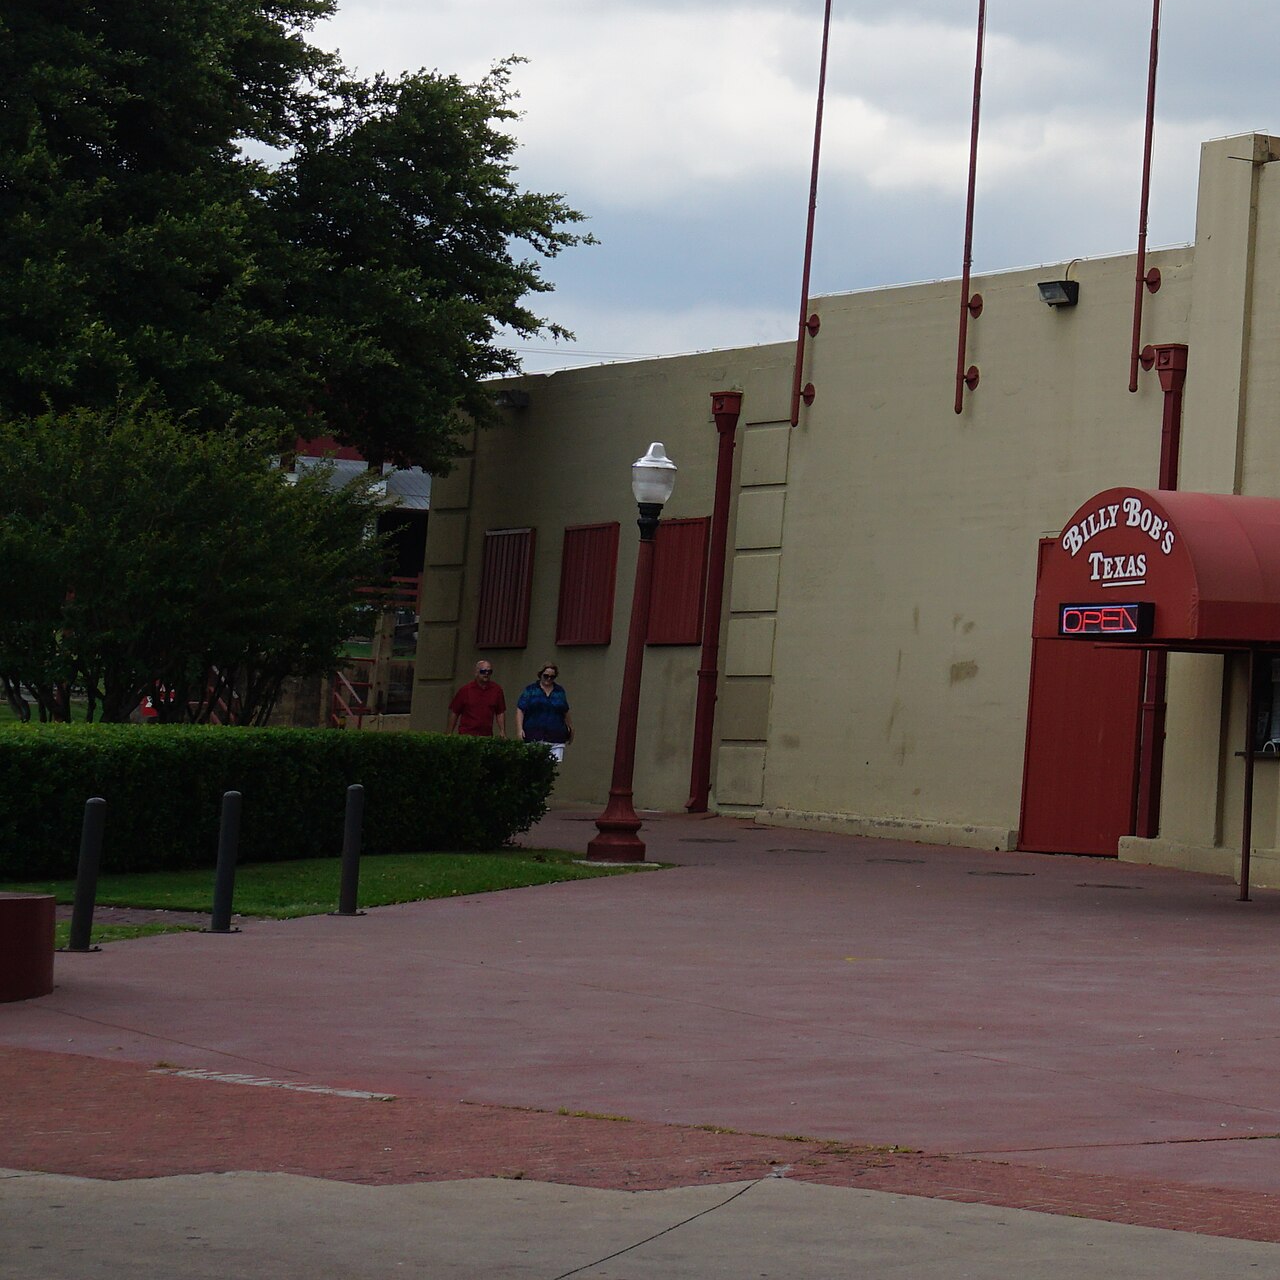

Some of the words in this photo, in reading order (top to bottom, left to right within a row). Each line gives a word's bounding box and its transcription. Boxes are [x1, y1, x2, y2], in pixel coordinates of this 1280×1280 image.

[1062, 504, 1120, 556] BILLY
[1123, 497, 1175, 554] BOB'S
[1088, 552, 1147, 581] TEXAS
[1064, 607, 1138, 632] OPEN
